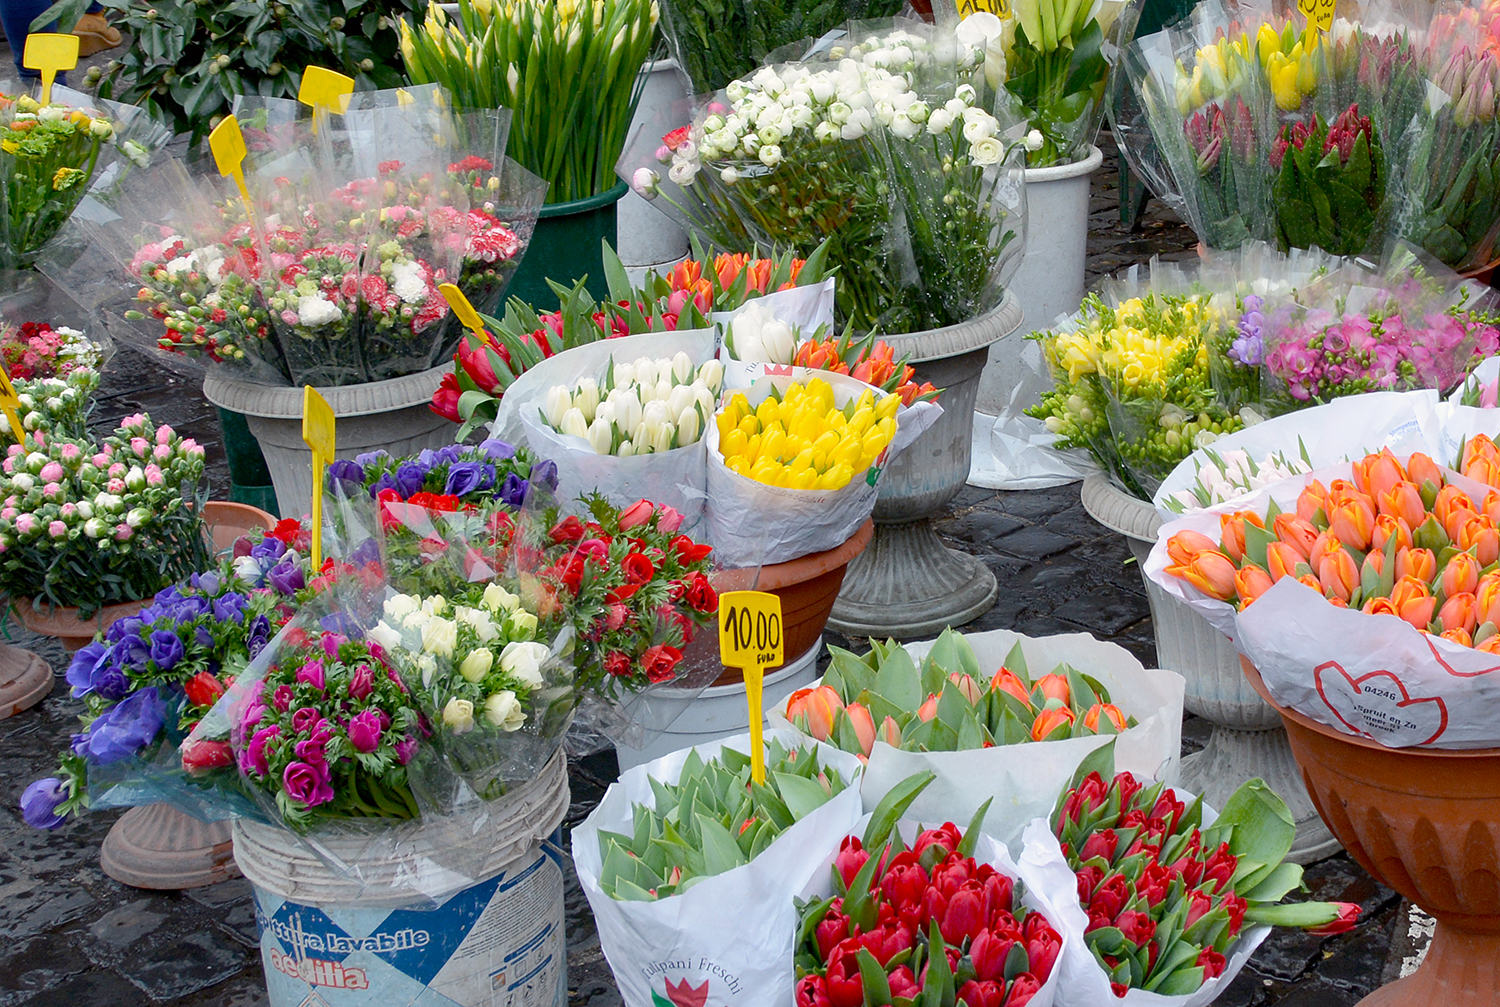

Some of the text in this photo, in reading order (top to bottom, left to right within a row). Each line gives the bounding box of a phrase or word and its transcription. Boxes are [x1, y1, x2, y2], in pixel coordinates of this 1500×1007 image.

[725, 606, 780, 652] 10.00
[757, 652, 776, 665] EURO
[1364, 685, 1397, 702] 04246
[1389, 716, 1402, 725] en
[1404, 720, 1418, 730] Zn
[326, 928, 431, 953] lavabile
[270, 947, 370, 990] aedilia
[641, 957, 745, 996] Tulipani Freschi
